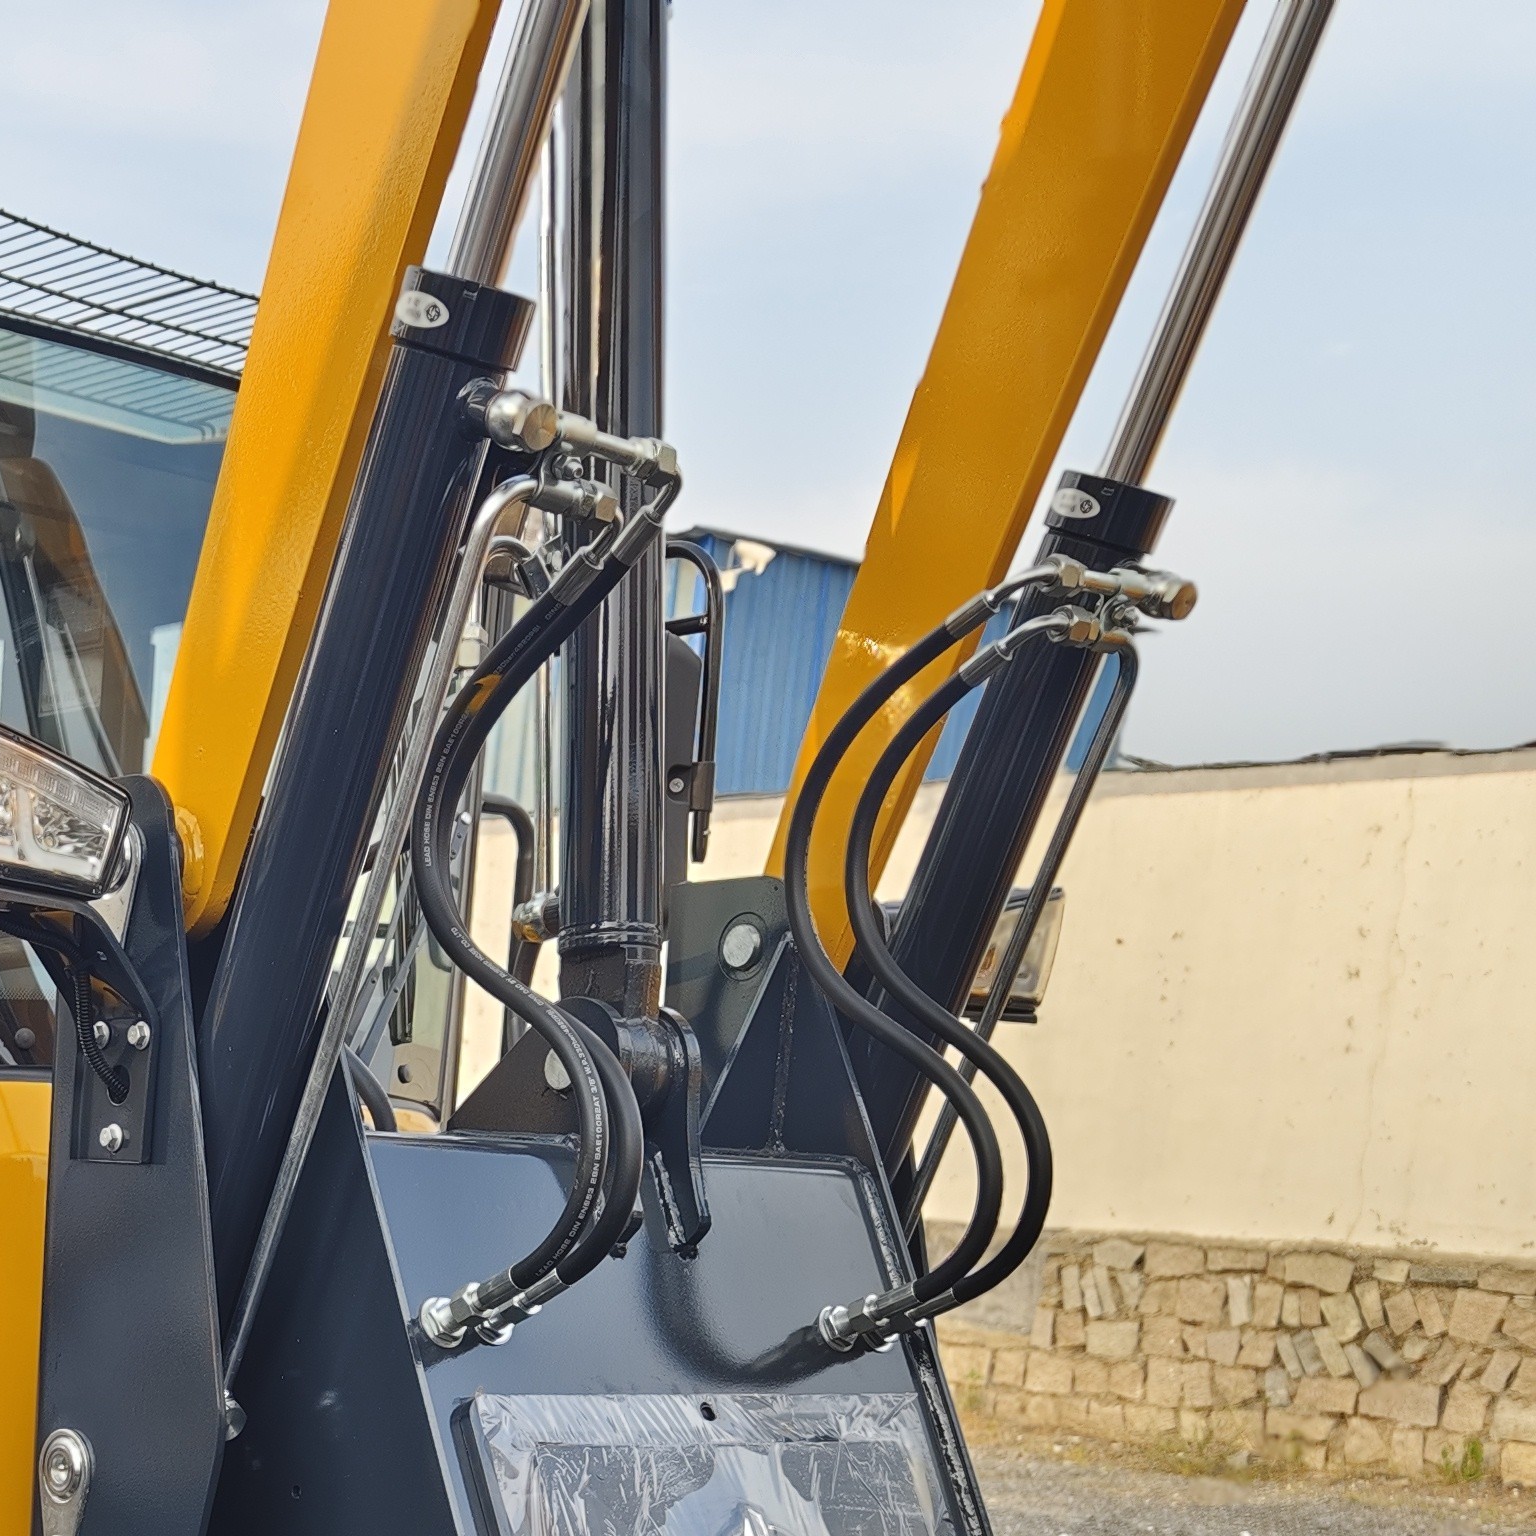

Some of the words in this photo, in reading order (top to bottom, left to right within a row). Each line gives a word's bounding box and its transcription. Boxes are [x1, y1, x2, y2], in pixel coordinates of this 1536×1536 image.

[424, 804, 433, 819] DIN
[423, 820, 432, 845] HOSE
[424, 845, 433, 868] LEAD
[568, 1220, 583, 1239] DIN
